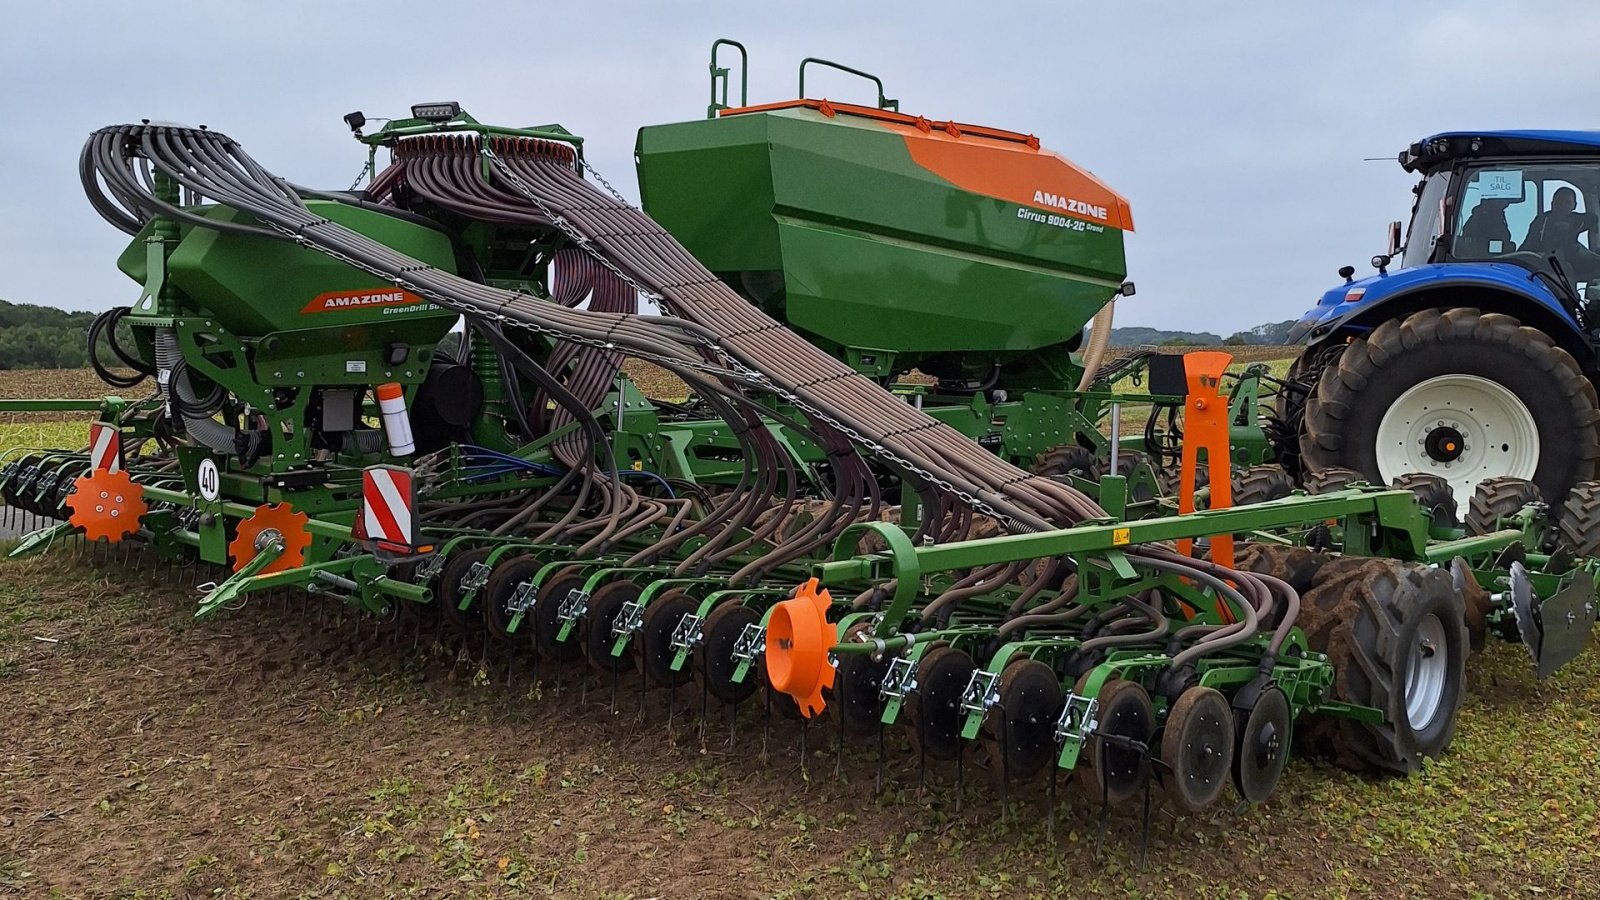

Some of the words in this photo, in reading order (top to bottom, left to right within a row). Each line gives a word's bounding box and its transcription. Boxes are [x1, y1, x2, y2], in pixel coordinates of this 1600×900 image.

[1489, 183, 1512, 191] SALG
[1494, 175, 1506, 183] TIL
[1033, 190, 1108, 220] AMAZONE
[1017, 207, 1046, 223] Cirrus
[1047, 214, 1085, 232] 9004-2C
[324, 292, 404, 308] AMAZONE
[383, 303, 428, 315] GreenDrill
[202, 466, 216, 494] 40
